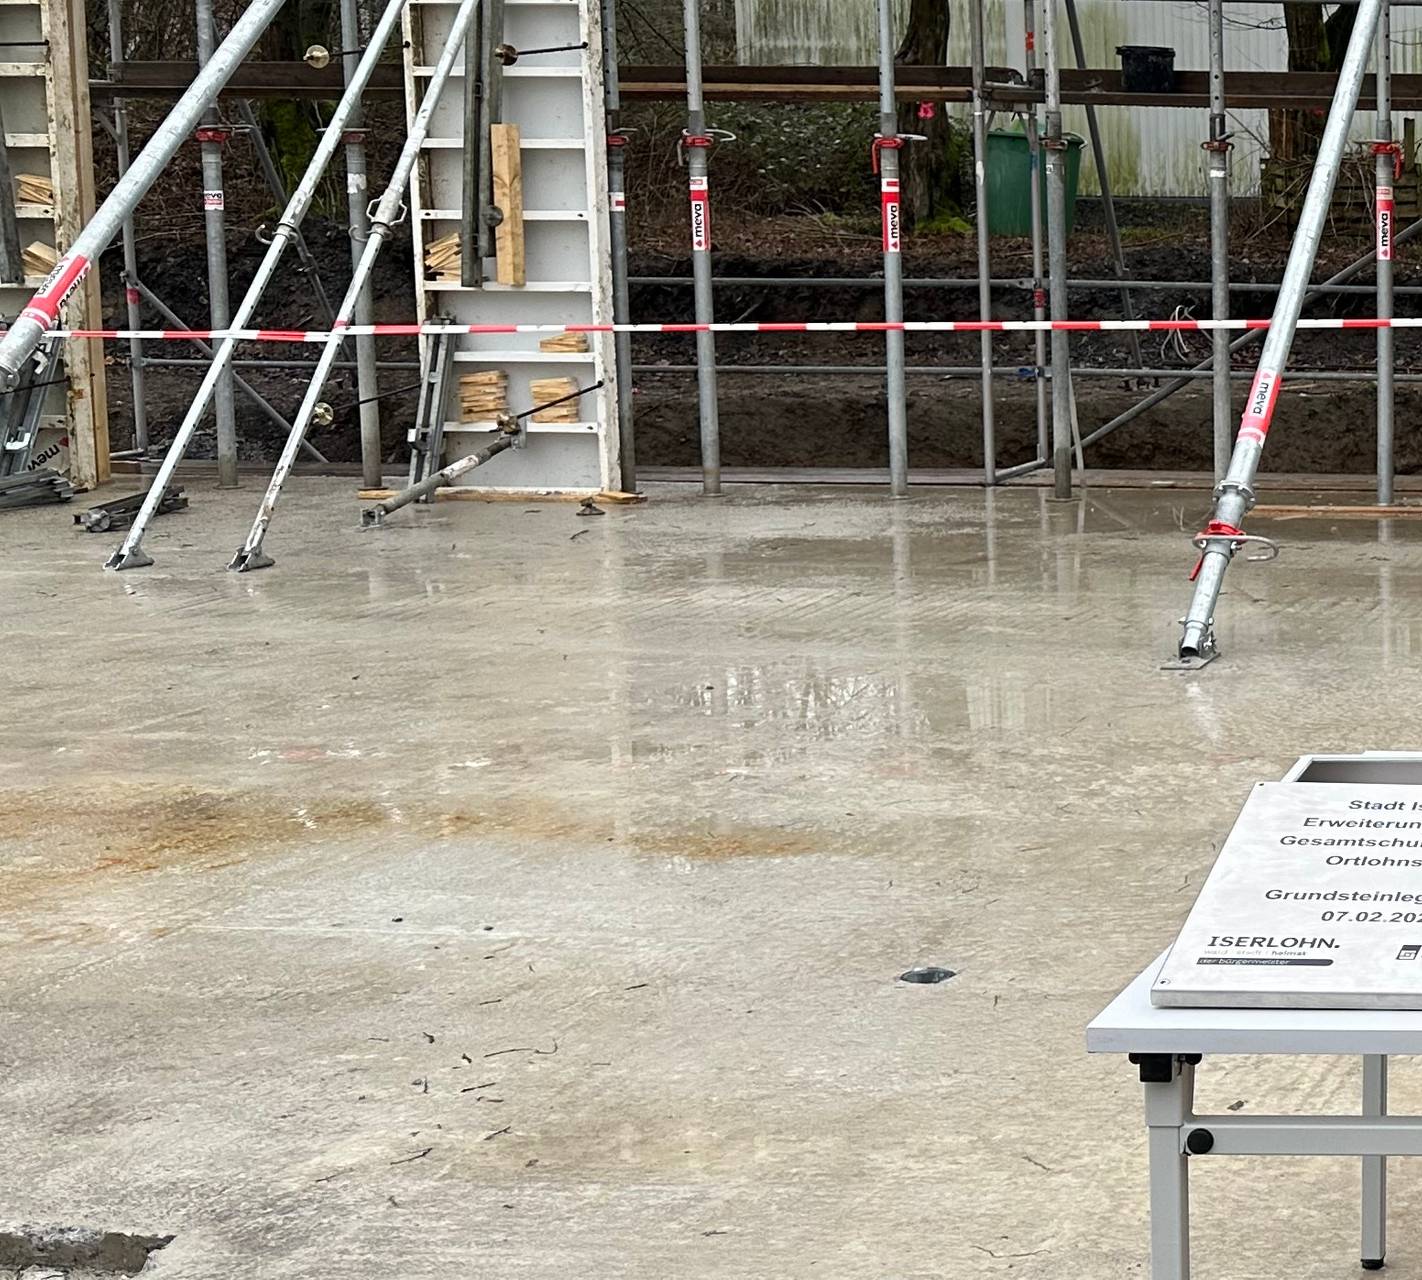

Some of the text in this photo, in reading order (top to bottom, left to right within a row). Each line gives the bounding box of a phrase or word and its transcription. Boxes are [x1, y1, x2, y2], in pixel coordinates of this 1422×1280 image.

[694, 203, 703, 238] meva
[890, 205, 899, 239] meva
[1381, 213, 1389, 247] meva
[1252, 382, 1270, 416] meva
[1348, 800, 1406, 811] Stadt
